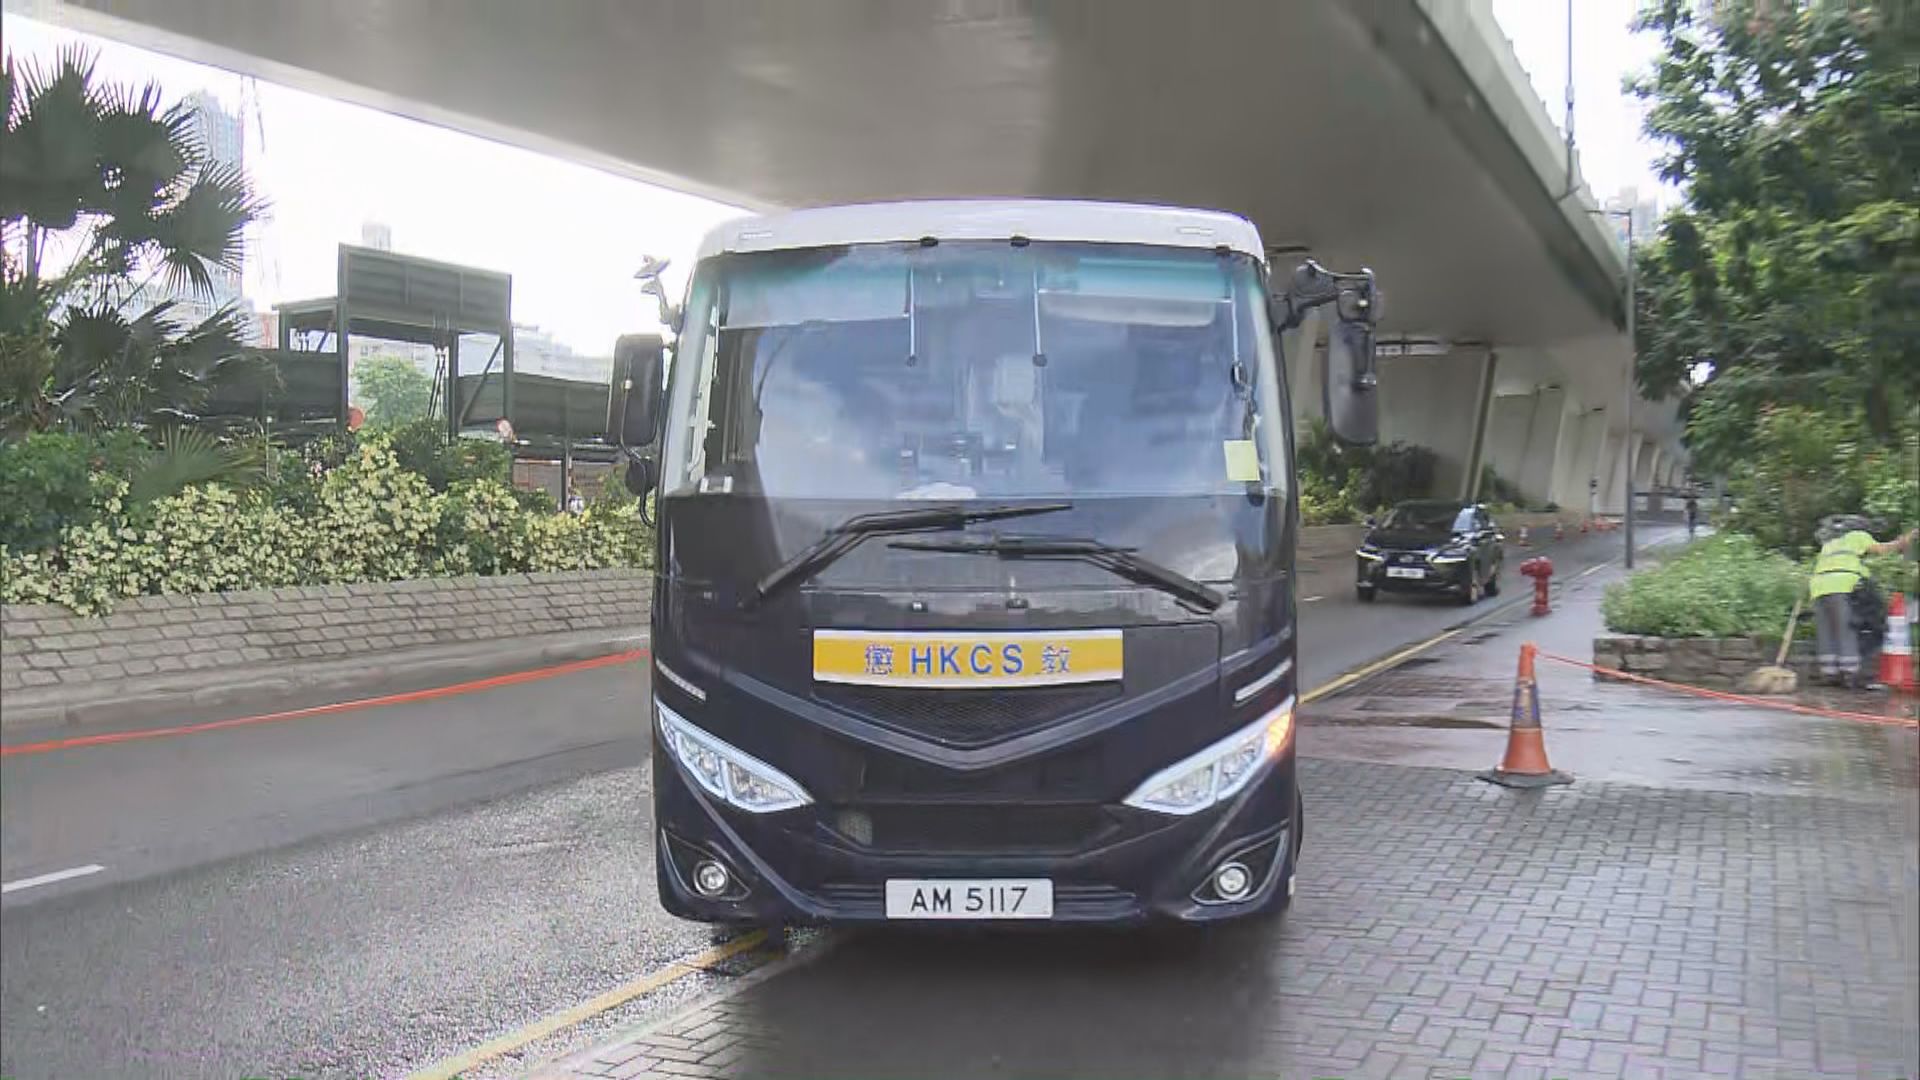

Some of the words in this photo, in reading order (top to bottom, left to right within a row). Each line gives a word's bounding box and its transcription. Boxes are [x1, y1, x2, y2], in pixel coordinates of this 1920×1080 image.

[911, 644, 1023, 674] HKCS
[911, 888, 952, 913] AM
[966, 888, 1027, 913] 5117
